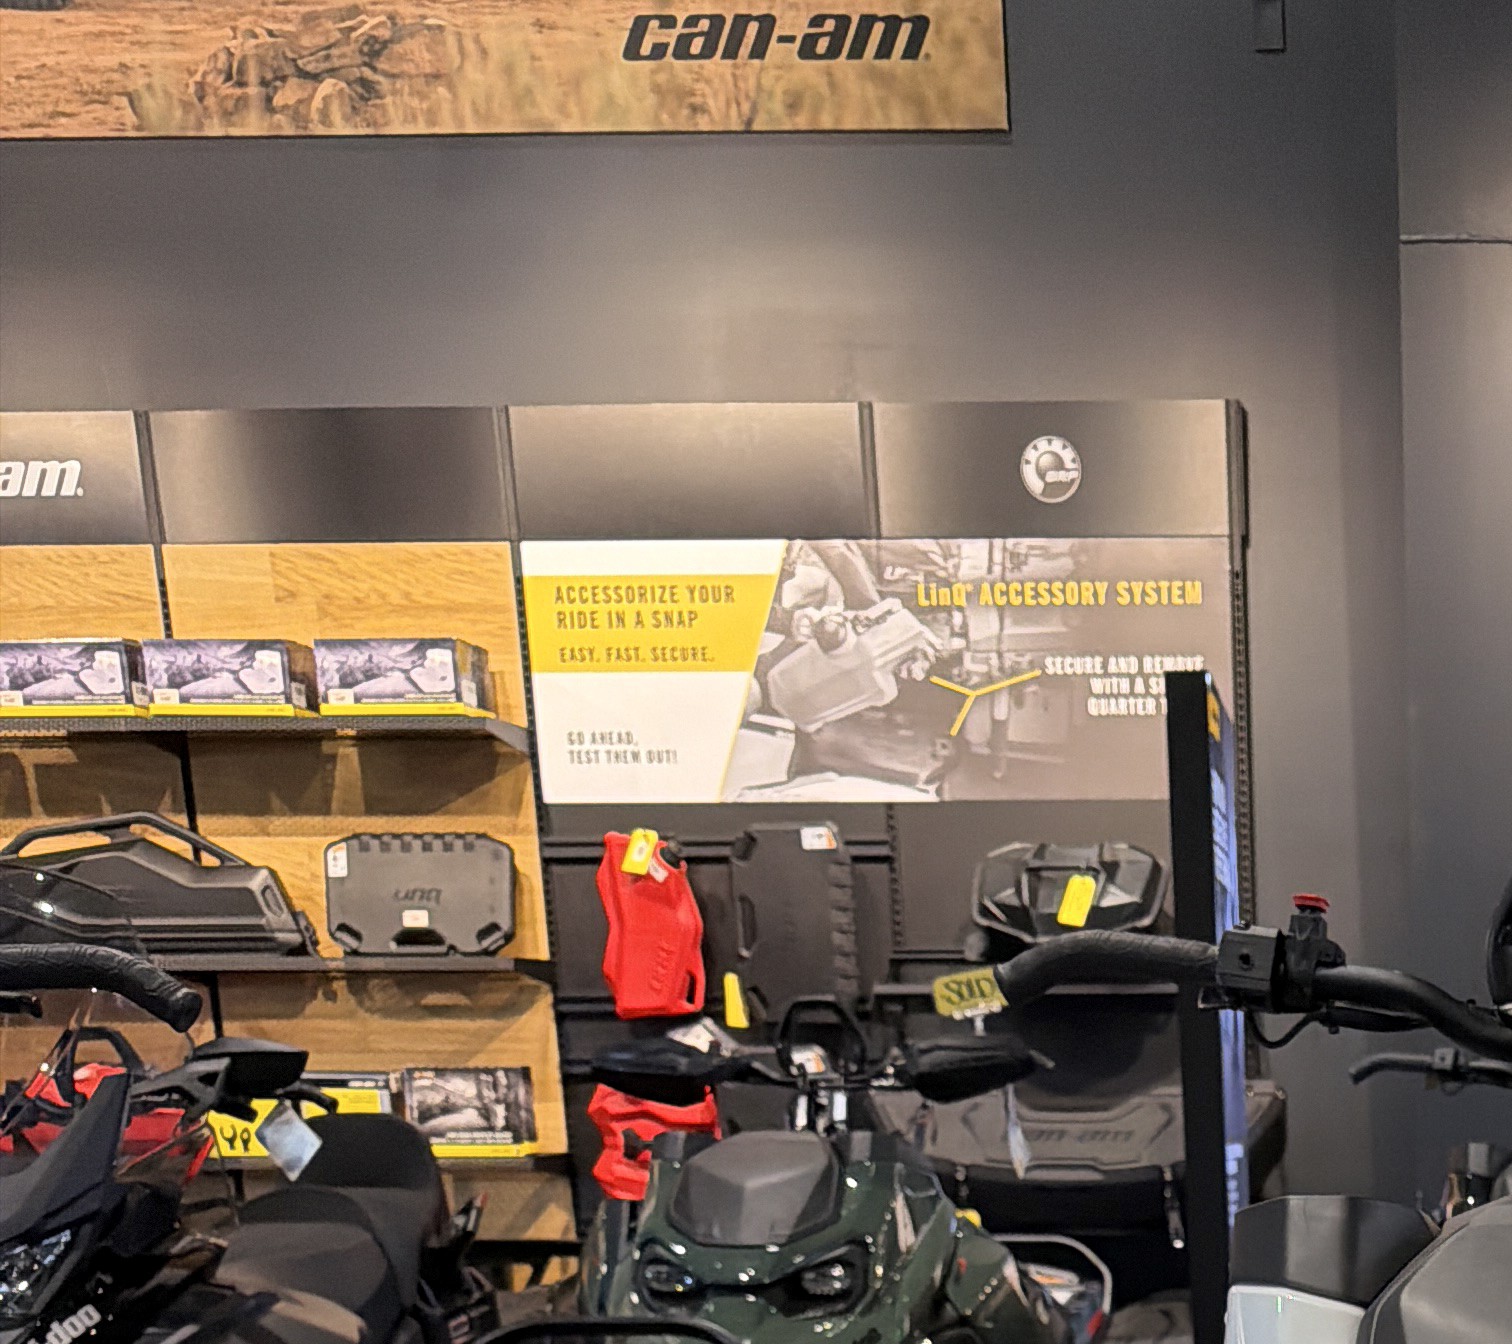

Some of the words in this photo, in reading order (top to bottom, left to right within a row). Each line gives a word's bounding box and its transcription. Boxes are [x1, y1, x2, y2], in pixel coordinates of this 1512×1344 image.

[622, 13, 931, 61] can-am
[554, 585, 679, 604] ACCESSORIZE
[686, 584, 735, 604] YOUR
[979, 581, 1108, 606] ACCESSORY
[1116, 580, 1203, 606] SYSTEM
[557, 611, 600, 629] RIDE
[607, 610, 627, 629] IN
[634, 610, 645, 629] A
[651, 610, 699, 629] SNAP
[1044, 656, 1104, 675] SECURE
[1108, 656, 1139, 675] AND
[1090, 677, 1131, 695] WITH
[1134, 678, 1146, 695] A
[1087, 697, 1158, 716] QUARTER
[566, 731, 585, 746] GO
[568, 749, 600, 764] TEST
[606, 749, 641, 764] THEM
